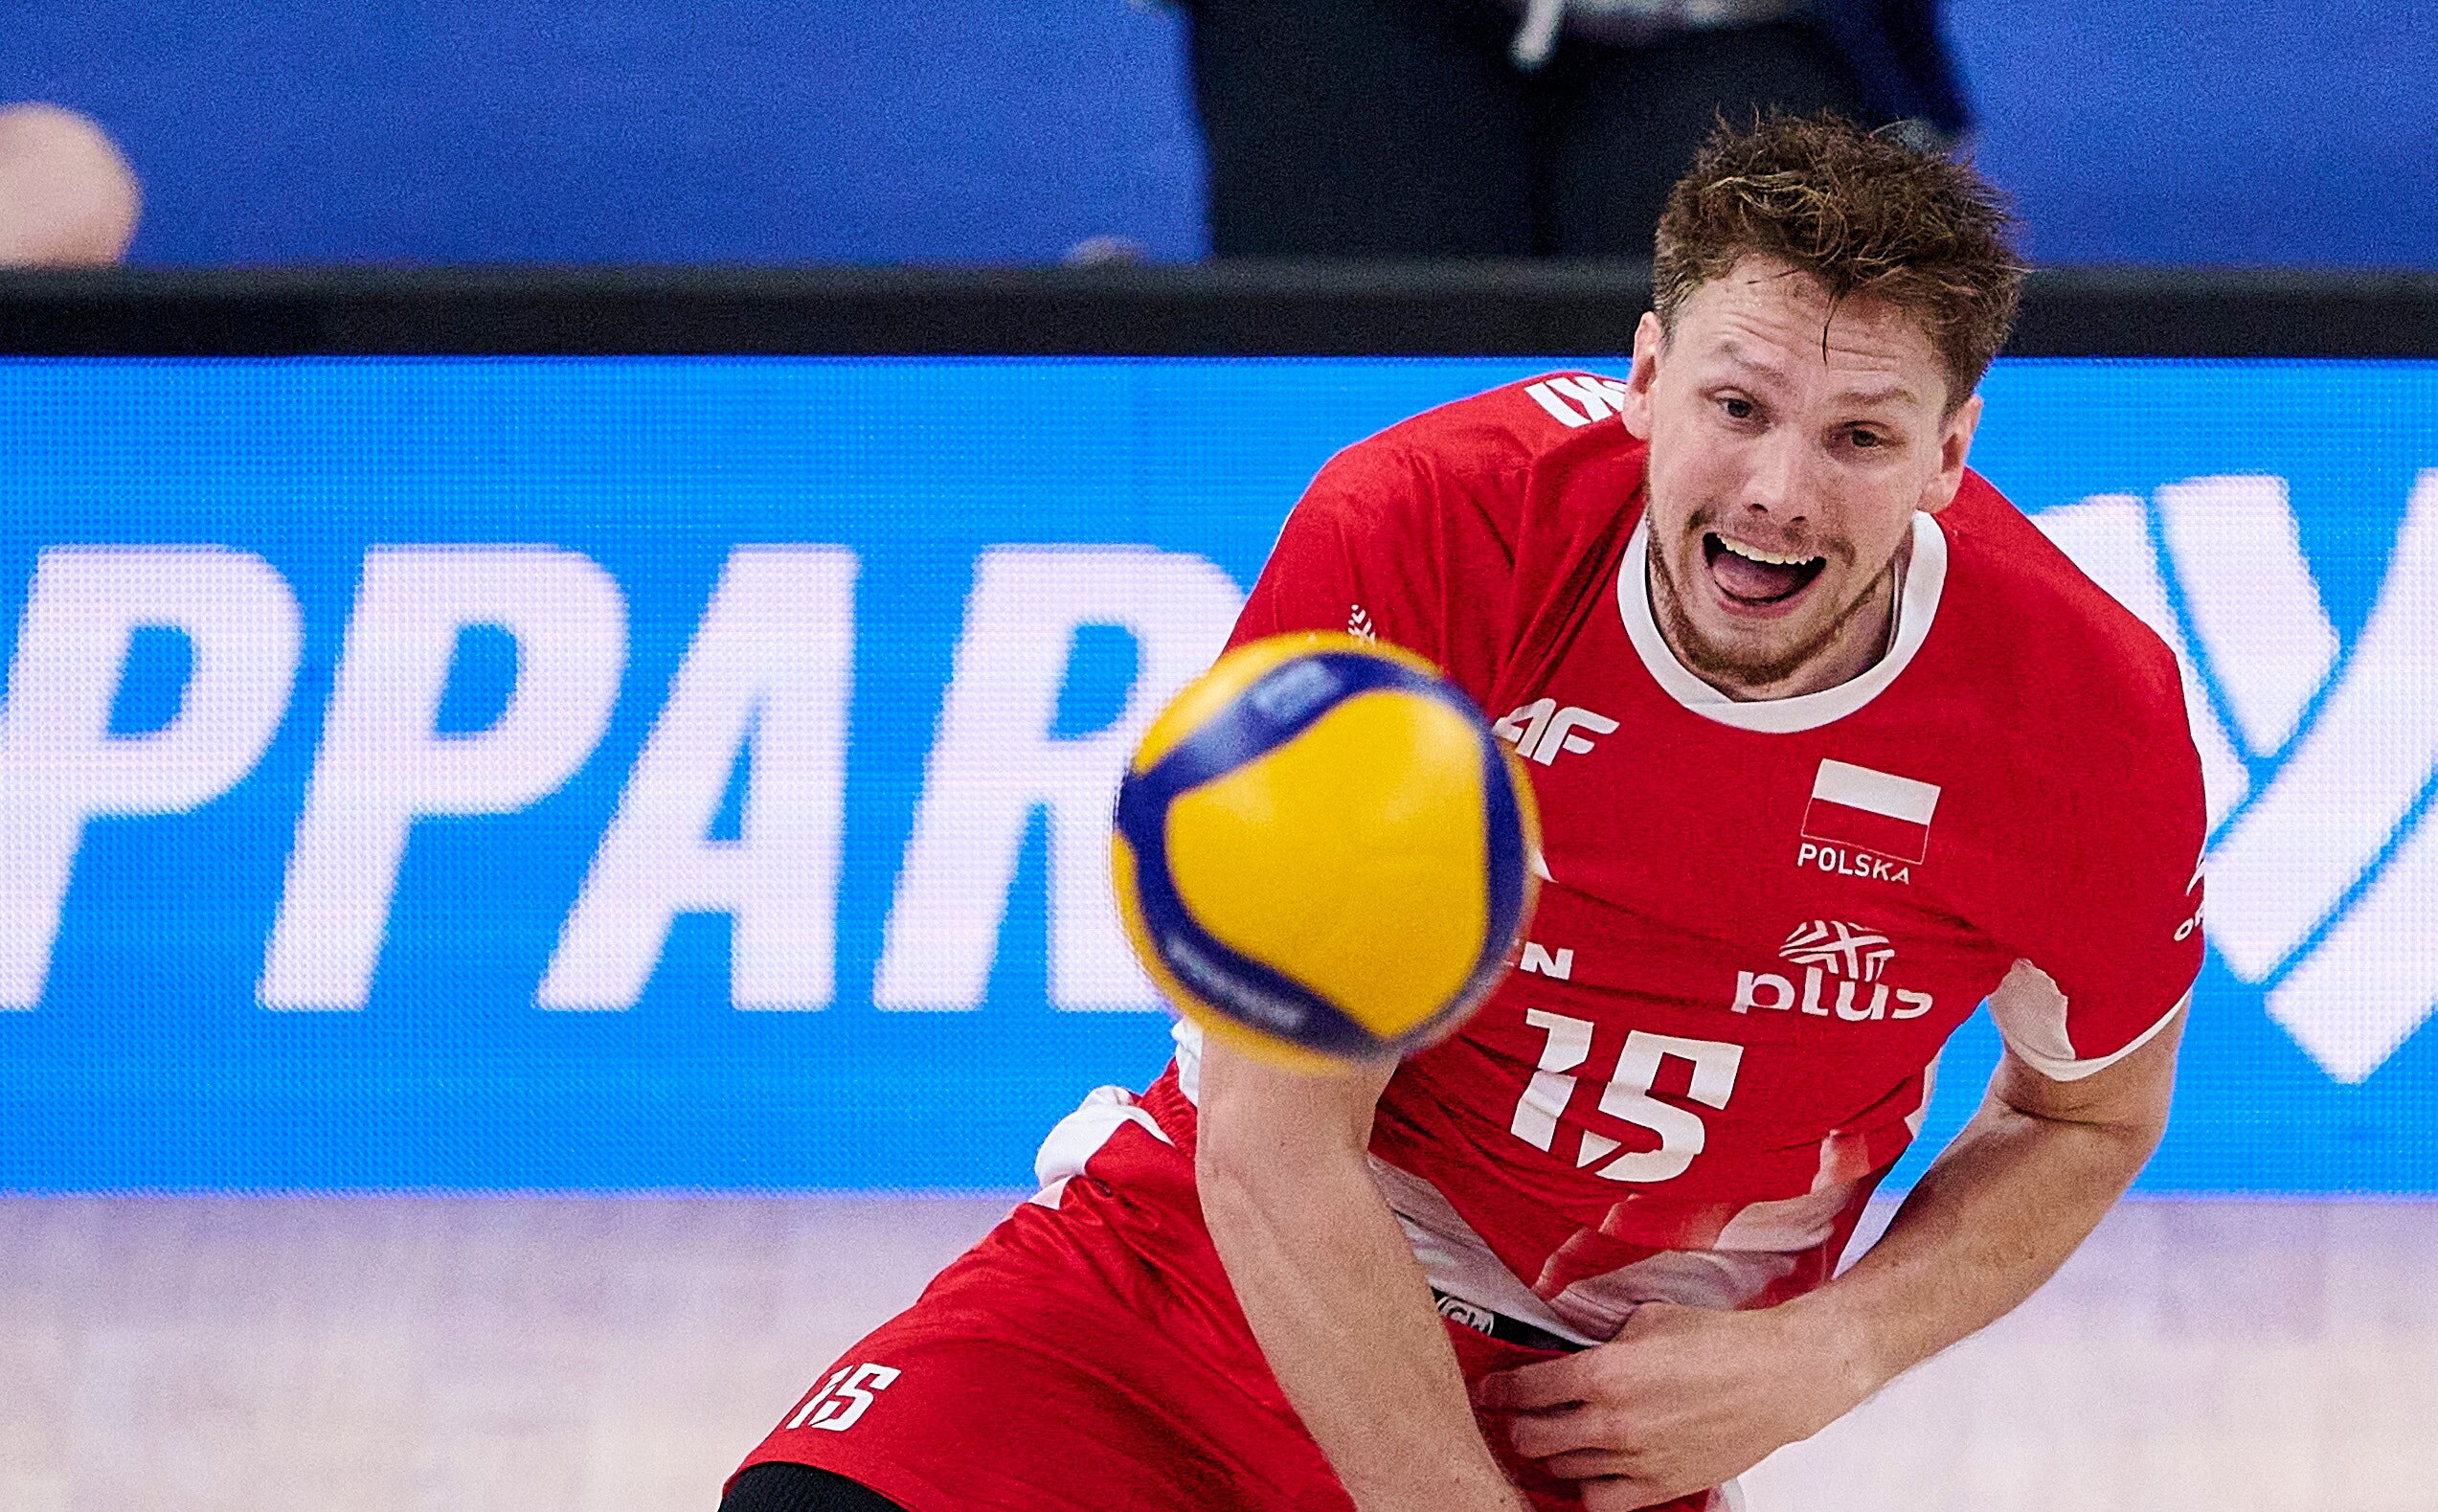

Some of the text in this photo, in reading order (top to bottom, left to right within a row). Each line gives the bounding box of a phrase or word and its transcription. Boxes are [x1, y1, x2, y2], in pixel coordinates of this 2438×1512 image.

[1796, 842, 1909, 885] POLSKA
[1730, 965, 1933, 1022] plus
[1510, 1007, 1745, 1184] 15
[785, 1362, 902, 1432] 15
